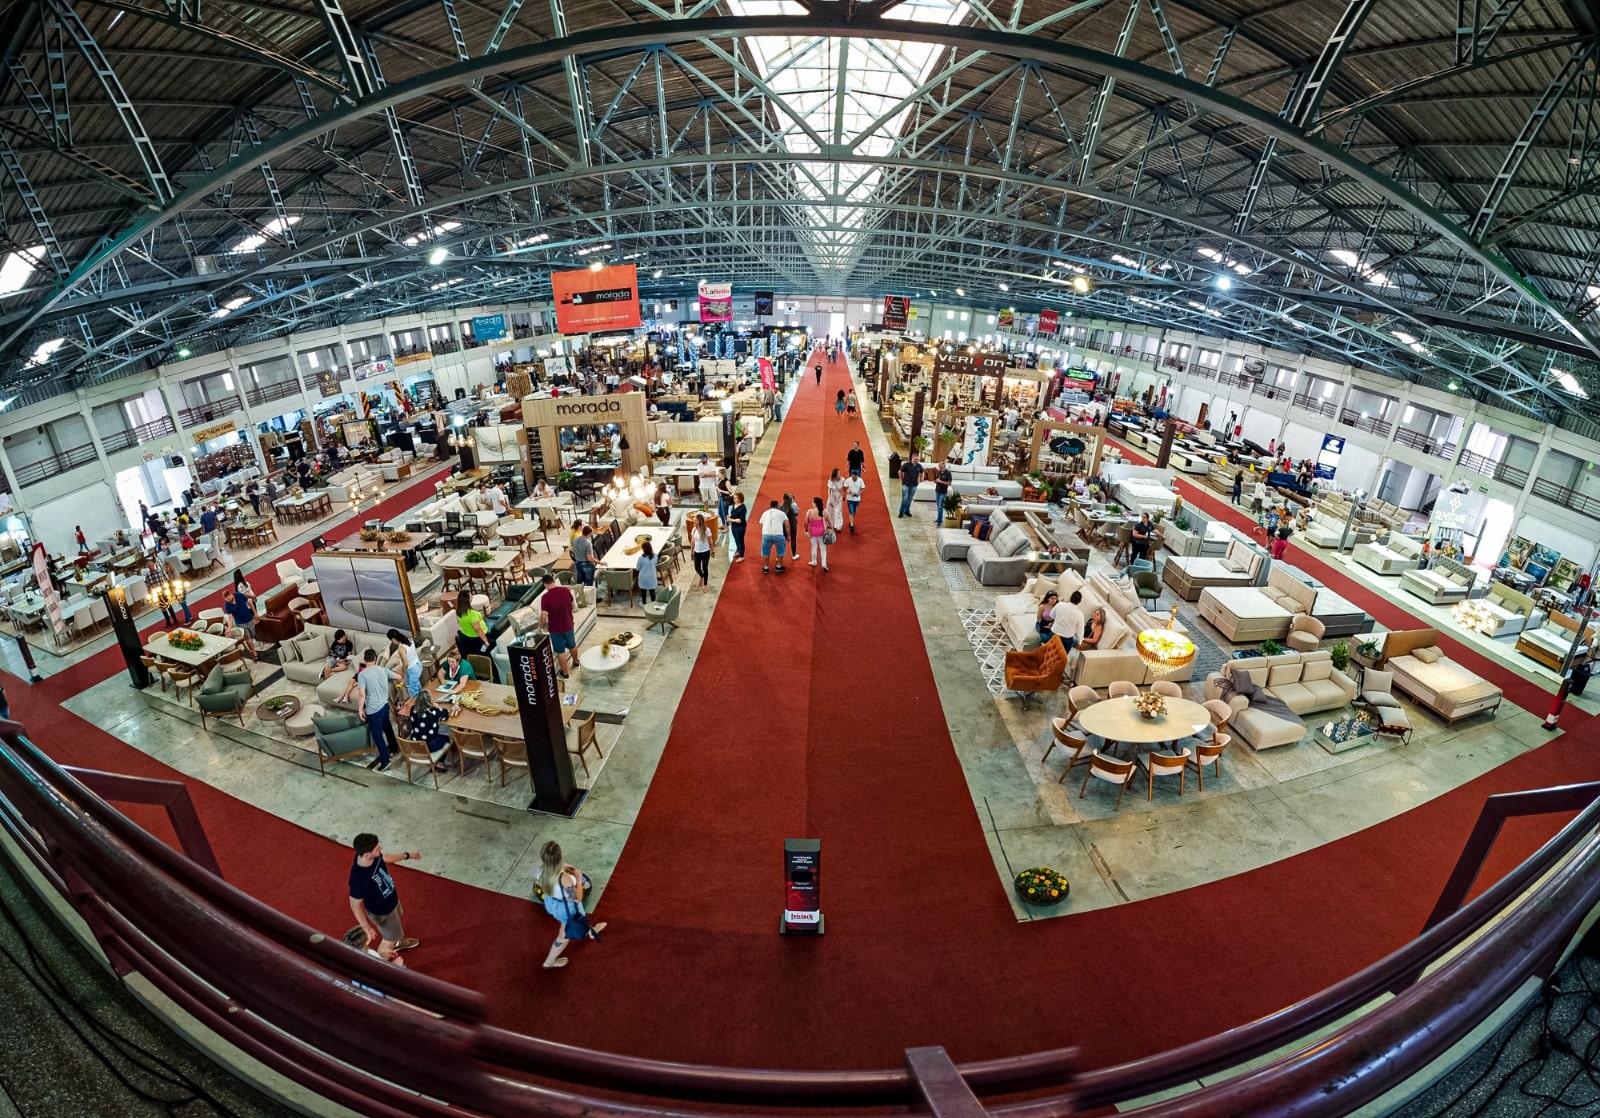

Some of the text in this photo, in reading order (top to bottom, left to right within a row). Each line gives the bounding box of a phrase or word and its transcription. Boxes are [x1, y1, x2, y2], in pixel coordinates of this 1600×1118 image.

[596, 290, 630, 300] morada
[705, 286, 730, 294] LaBelle
[1041, 316, 1057, 324] Think
[556, 399, 620, 414] morada
[542, 647, 555, 698] morada
[520, 655, 537, 705] morada
[791, 913, 814, 921] feistock
